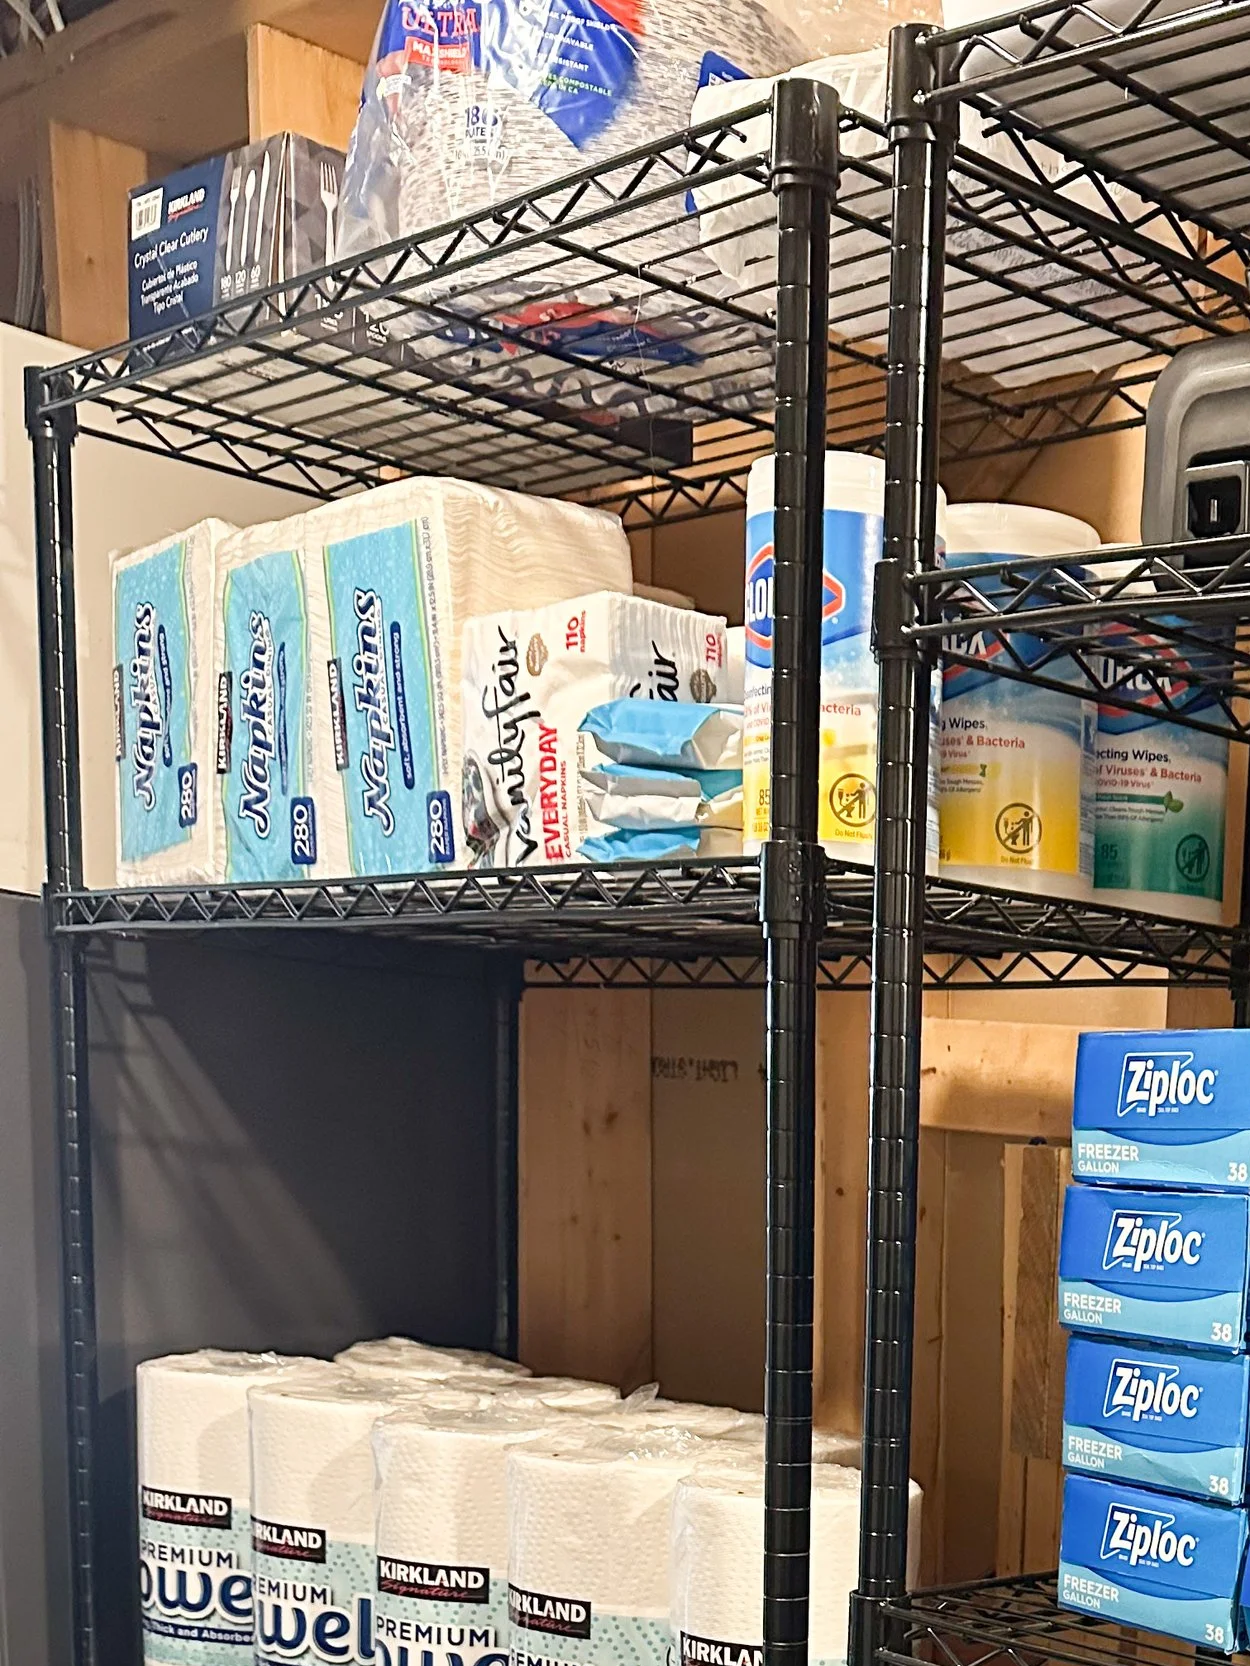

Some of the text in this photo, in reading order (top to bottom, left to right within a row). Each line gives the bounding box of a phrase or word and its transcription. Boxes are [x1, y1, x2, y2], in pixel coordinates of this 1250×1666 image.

[158, 237, 178, 257] Clear
[180, 227, 209, 248] Cutlery
[564, 615, 580, 651] 110
[704, 633, 718, 663] 110
[133, 601, 163, 812] Napkins
[328, 661, 345, 765] KIRKLAND
[353, 587, 396, 838] Napkins
[216, 675, 228, 771] KIRKLAND
[238, 609, 276, 840] Napkins
[966, 738, 974, 747] &
[976, 735, 1026, 750] Bacteria
[1150, 767, 1158, 777] &
[1160, 768, 1203, 783] Bacteria
[180, 769, 194, 821] 280
[537, 721, 564, 863] EVERYDAY
[558, 759, 572, 859] CASUAL NAPKINS
[292, 802, 309, 858] 280
[428, 798, 445, 857] 280
[1125, 1058, 1215, 1117] Ziploc
[1077, 1142, 1140, 1162] FREEZER
[1077, 1159, 1120, 1174] GALLON
[1227, 1161, 1249, 1183] 38
[1111, 1217, 1203, 1273] Ziploc
[1063, 1291, 1122, 1314] FREEZER
[1063, 1308, 1104, 1325] GALLON
[1210, 1321, 1233, 1342] 38
[1111, 1366, 1200, 1423] Ziploc
[1067, 1434, 1123, 1461] FREEZER
[1067, 1452, 1105, 1470] GALLON
[1208, 1474, 1230, 1495] 38
[142, 1490, 229, 1517] KIRKLAND
[1108, 1510, 1196, 1567] Ziploc
[141, 1539, 234, 1569] PREMIUM
[379, 1558, 486, 1590] KIRKLAND
[1063, 1573, 1120, 1603] FREEZER
[1062, 1588, 1101, 1610] GALLON
[177, 1627, 199, 1640] and
[377, 1616, 489, 1649] PREMIUM
[1204, 1623, 1225, 1645] 38
